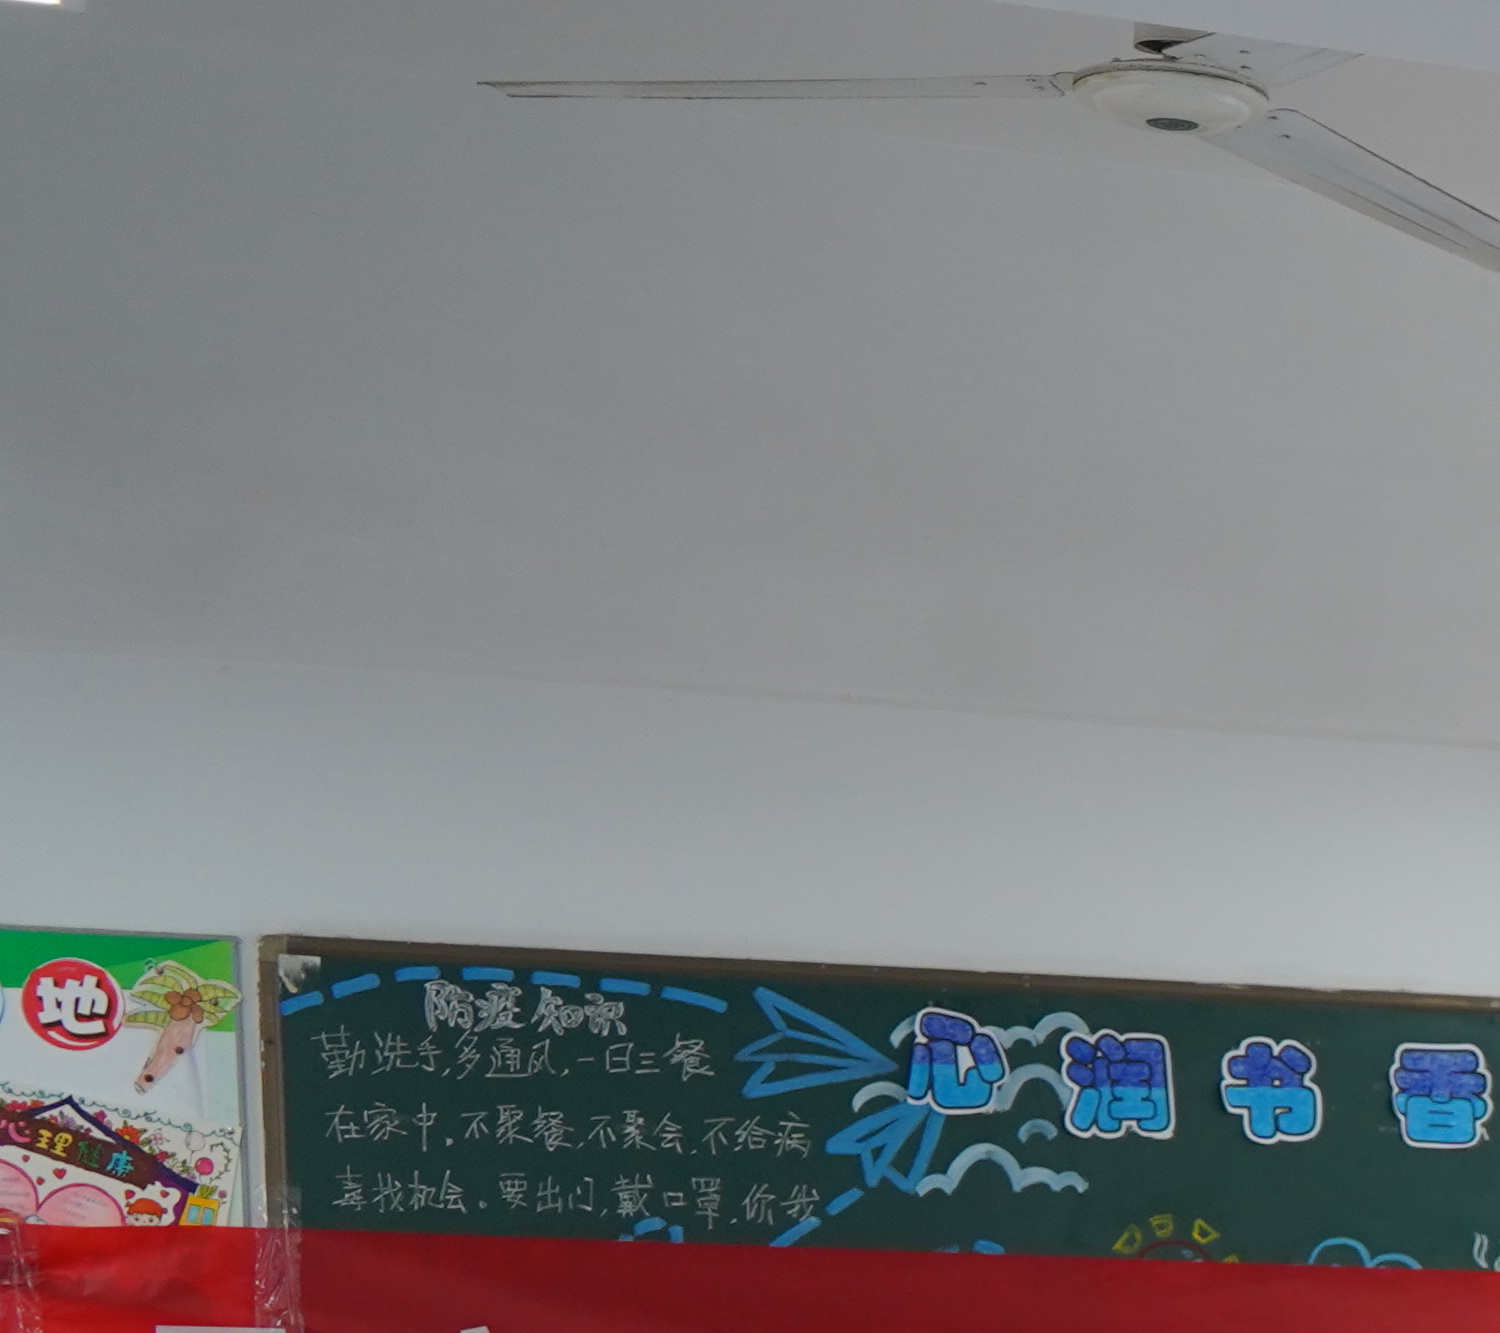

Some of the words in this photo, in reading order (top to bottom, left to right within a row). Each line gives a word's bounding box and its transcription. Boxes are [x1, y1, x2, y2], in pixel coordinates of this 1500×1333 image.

[36, 974, 109, 1034] 地
[424, 980, 628, 1037] 防疫知识
